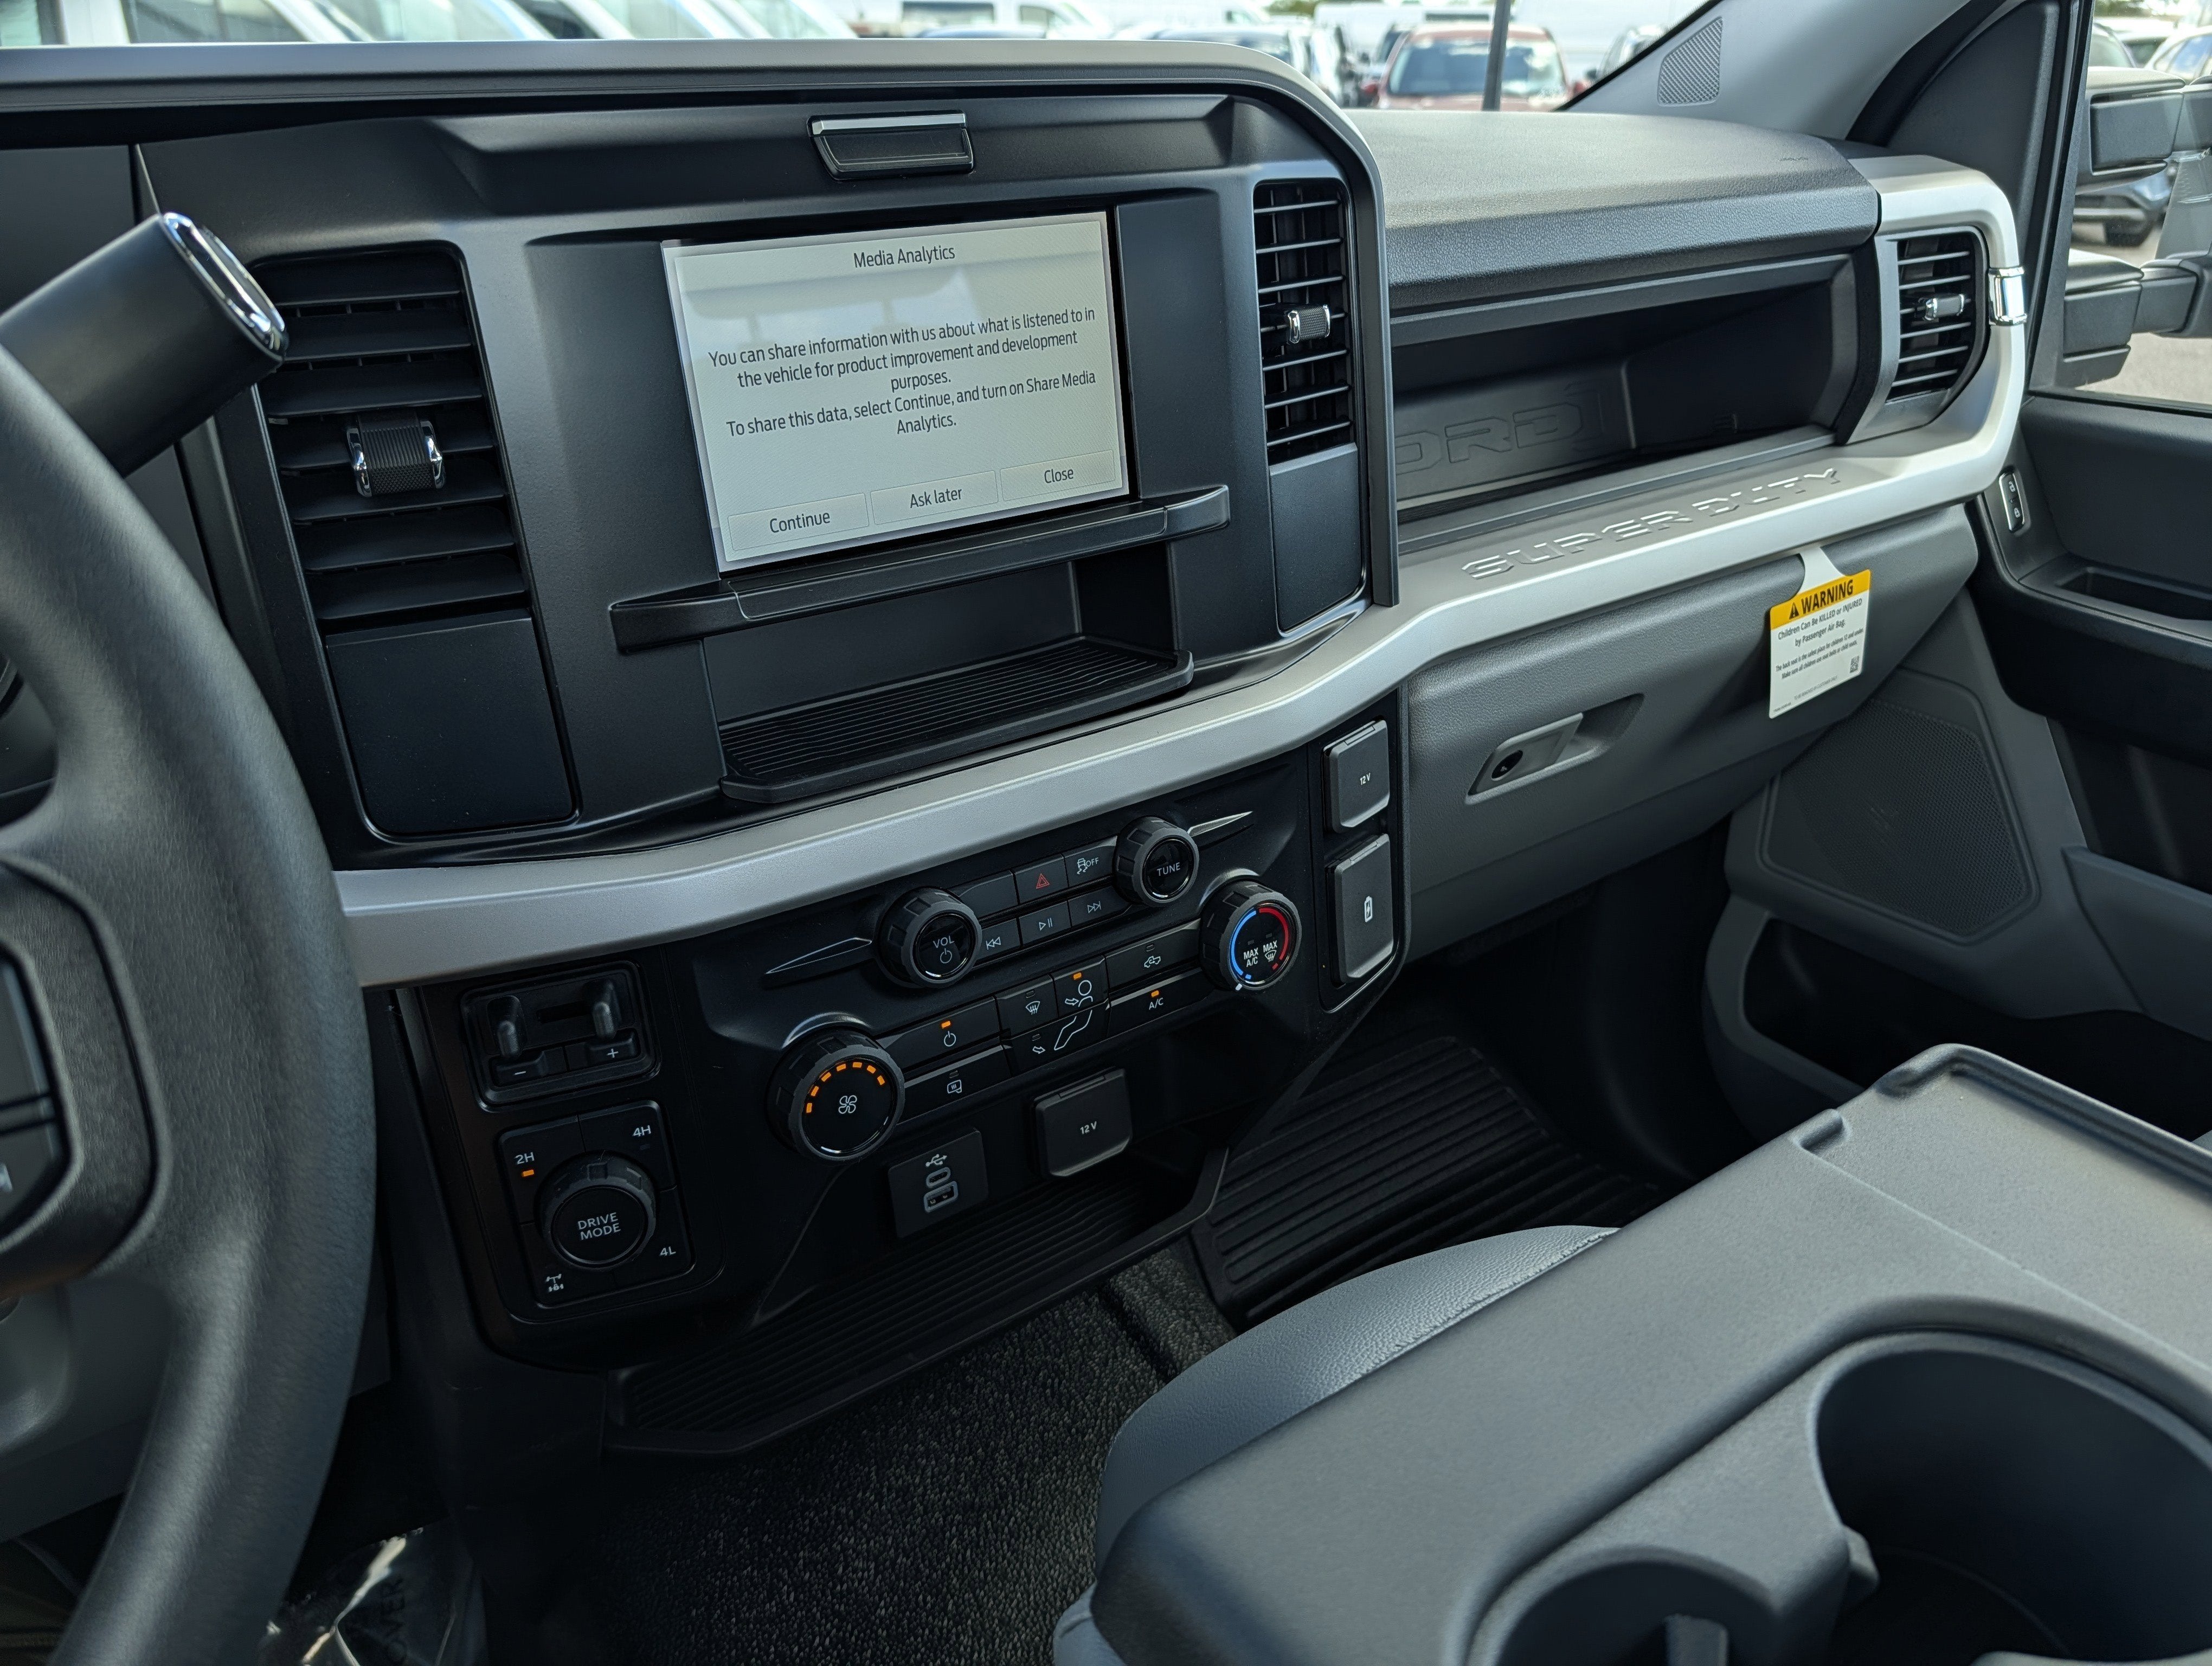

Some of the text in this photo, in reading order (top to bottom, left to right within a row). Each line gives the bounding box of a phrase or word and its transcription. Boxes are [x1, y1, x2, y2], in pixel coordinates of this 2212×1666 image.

[853, 245, 956, 268] Media Analytics
[707, 306, 1096, 368] You can share information with us about what is listened to in
[736, 330, 1078, 388] the vehicle for product improvement and development
[890, 371, 951, 394] purposes.
[725, 370, 1097, 437] To share this data, select Continue, and turn on Share Media
[896, 413, 957, 435] Analytics.
[1396, 401, 1584, 475] ORD
[1043, 468, 1075, 484] Close
[909, 488, 963, 509] Ask later
[769, 512, 831, 534] Continue
[1462, 467, 1841, 579] SUPER DUTY
[1801, 579, 1854, 615] WARNING
[1778, 623, 1799, 640] Children
[1801, 619, 1810, 631] Can
[1811, 616, 1818, 626] Be
[1818, 608, 1835, 623] KILLED
[1842, 597, 1862, 613] INJURED
[1795, 636, 1801, 648] by
[1802, 626, 1827, 645] Passenger
[1835, 617, 1846, 630] Bag.
[1085, 857, 1099, 868] OFF
[1156, 862, 1181, 876] TUNE
[933, 935, 955, 949] VOL
[1263, 940, 1278, 953] MAX
[1243, 947, 1259, 960] MAX
[1246, 956, 1258, 967] A/C
[1148, 997, 1164, 1010] A/C
[632, 1125, 652, 1138] 4H
[515, 1151, 535, 1165] 2H
[577, 1212, 619, 1231] DRIVE
[580, 1222, 621, 1241] MODE
[659, 1246, 677, 1257] 4L
